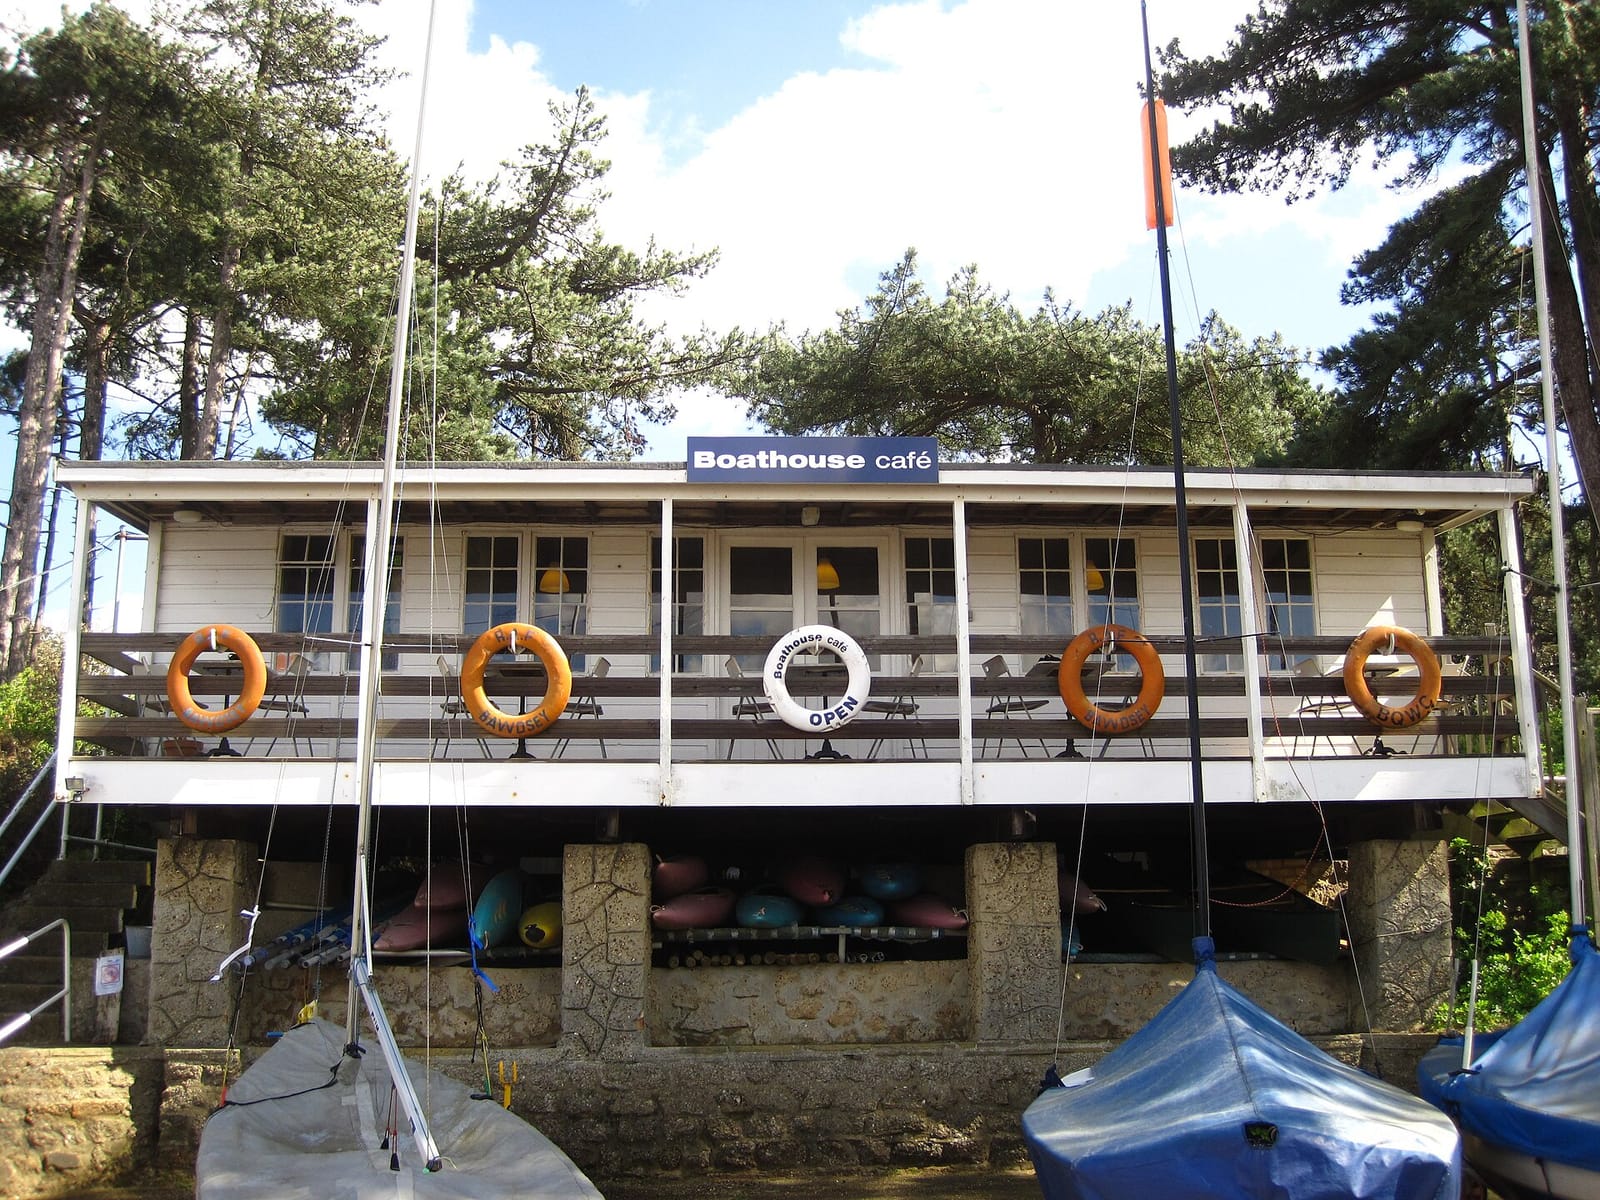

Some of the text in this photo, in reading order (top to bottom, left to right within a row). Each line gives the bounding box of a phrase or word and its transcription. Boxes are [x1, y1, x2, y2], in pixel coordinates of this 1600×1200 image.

[693, 450, 932, 470] Boathouse café
[773, 633, 849, 680] Boathouse café
[808, 695, 860, 722] OPEN
[479, 709, 551, 735] BAWDSEY
